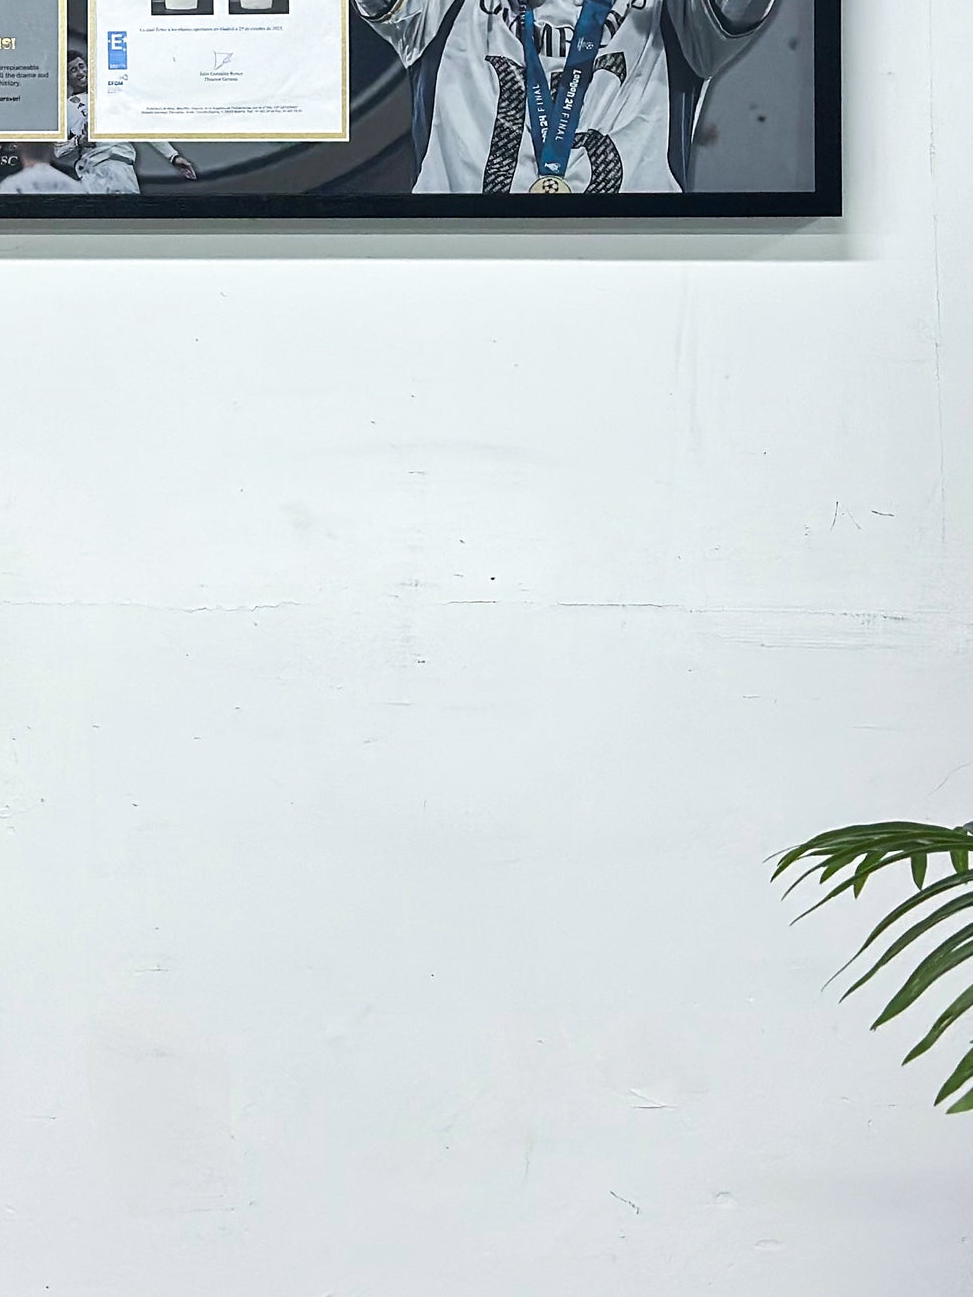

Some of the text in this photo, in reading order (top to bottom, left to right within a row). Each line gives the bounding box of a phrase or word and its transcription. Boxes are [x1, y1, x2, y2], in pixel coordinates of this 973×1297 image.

[532, 84, 545, 113] FINAL
[562, 97, 574, 111] 24
[538, 115, 548, 127] 24
[554, 112, 570, 141] FINAL
